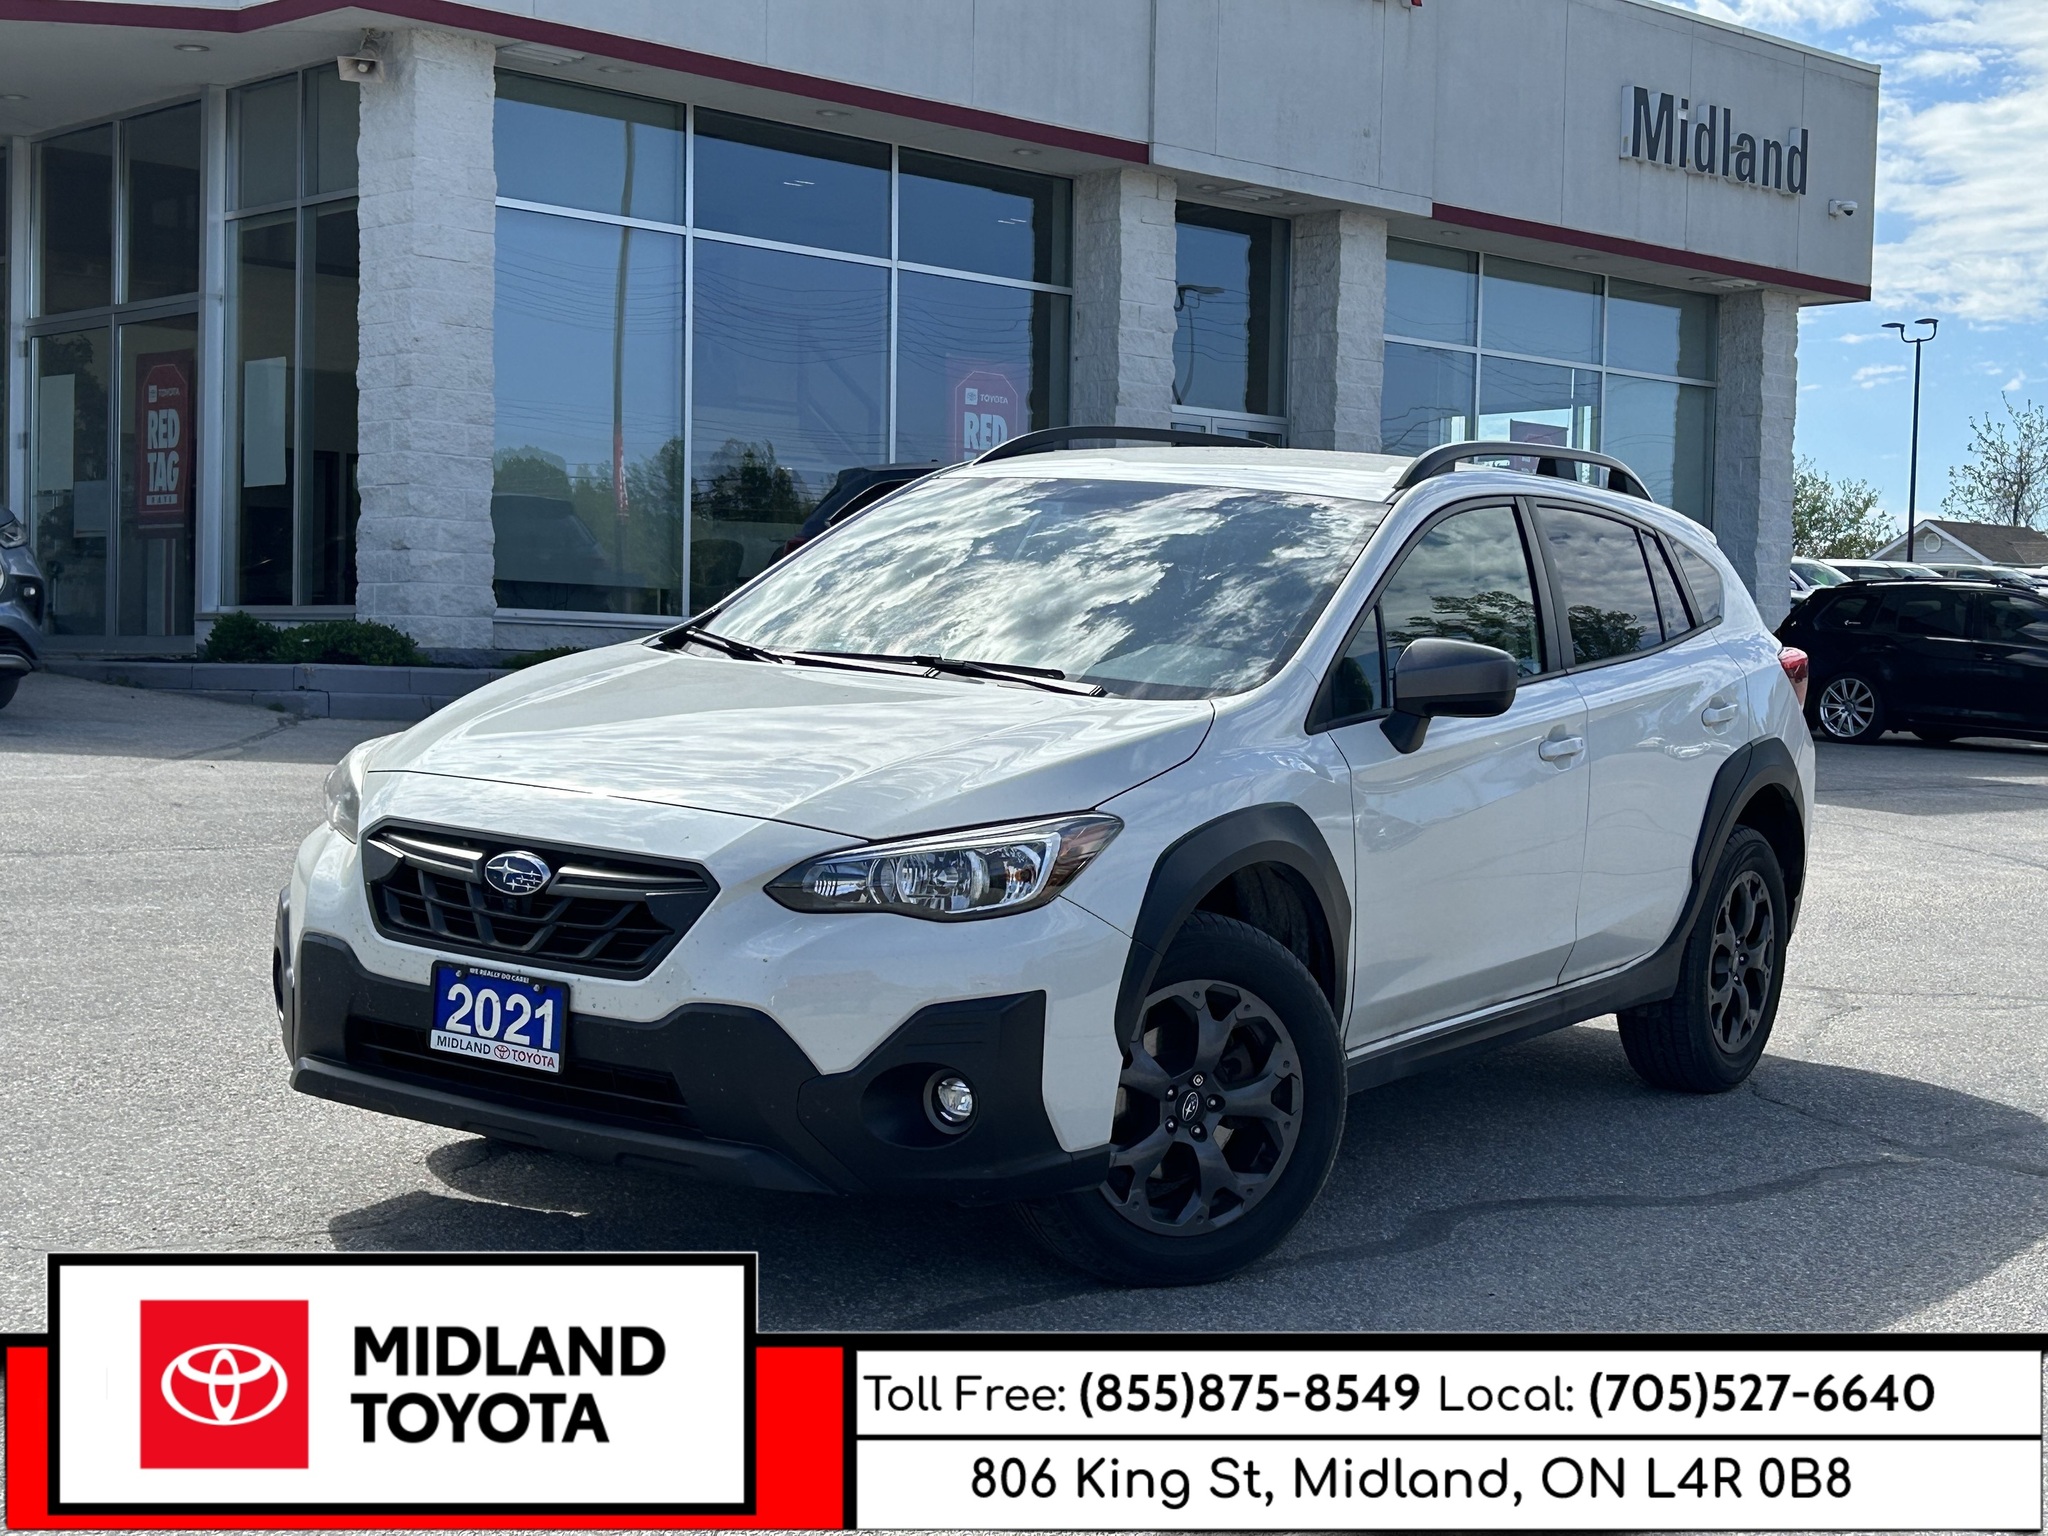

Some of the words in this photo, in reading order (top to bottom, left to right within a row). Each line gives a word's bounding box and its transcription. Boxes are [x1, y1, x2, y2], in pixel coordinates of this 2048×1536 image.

[1622, 85, 1809, 196] Midland
[980, 394, 1008, 404] TOYOTA
[147, 408, 180, 449] RED
[963, 411, 1008, 450] RED
[147, 450, 180, 492] TAG
[445, 983, 554, 1050] 2021
[436, 1035, 491, 1055] MIDLAND
[511, 1048, 556, 1069] TOYOTA
